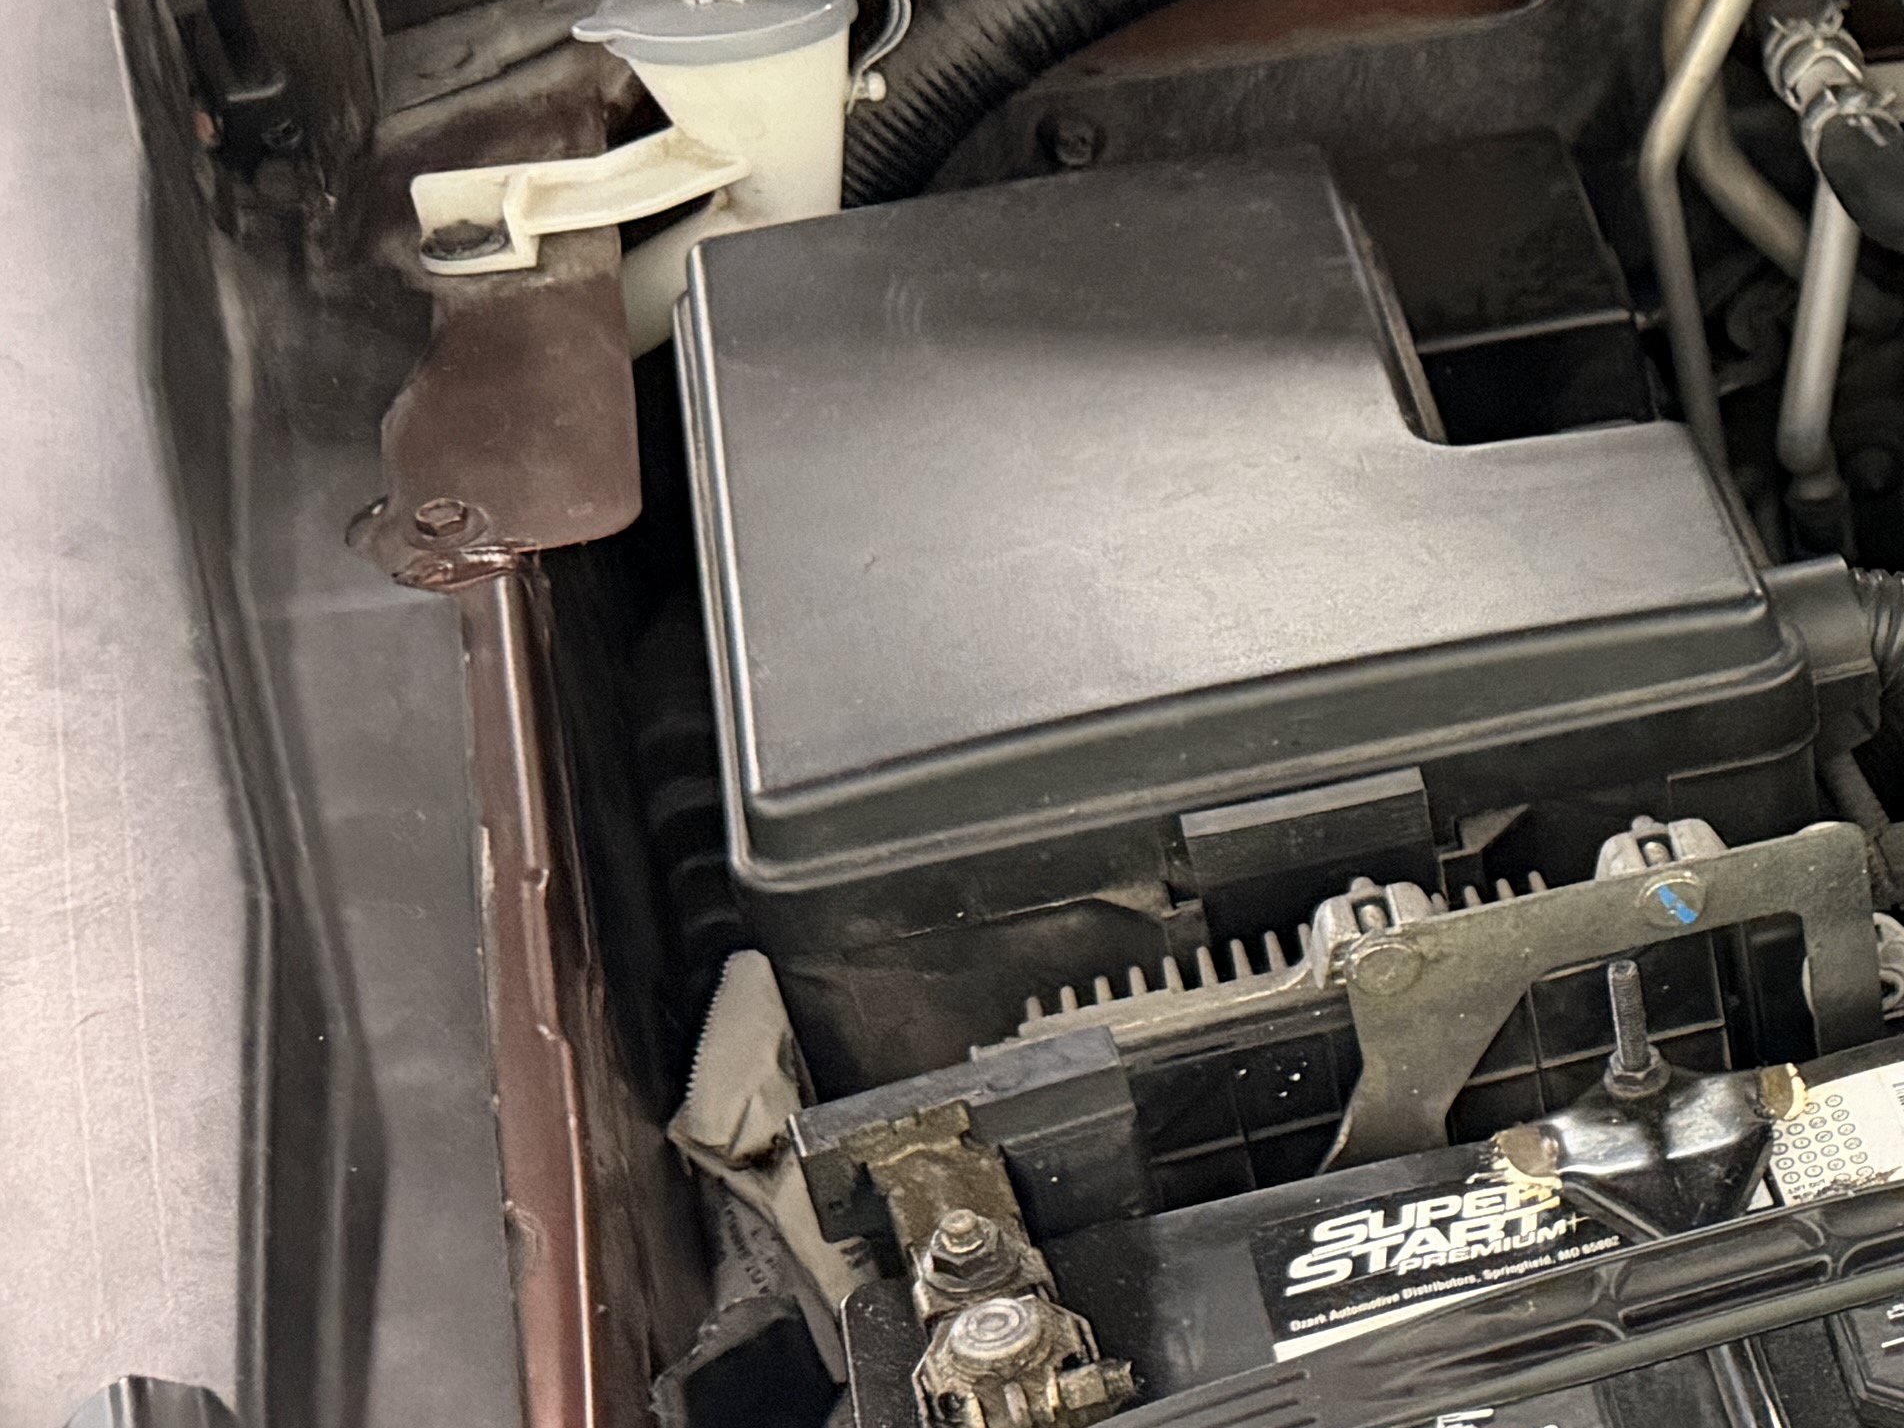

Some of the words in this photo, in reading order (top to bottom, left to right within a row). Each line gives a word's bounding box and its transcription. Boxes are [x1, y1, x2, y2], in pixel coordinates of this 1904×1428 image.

[1284, 1198, 1561, 1296] START
[1311, 1184, 1562, 1250] SUPER
[1397, 1224, 1566, 1276] PREMIUM
[1290, 1313, 1327, 1332] Ozark
[1329, 1293, 1400, 1323] Automotive
[1556, 1245, 1579, 1262] MO
